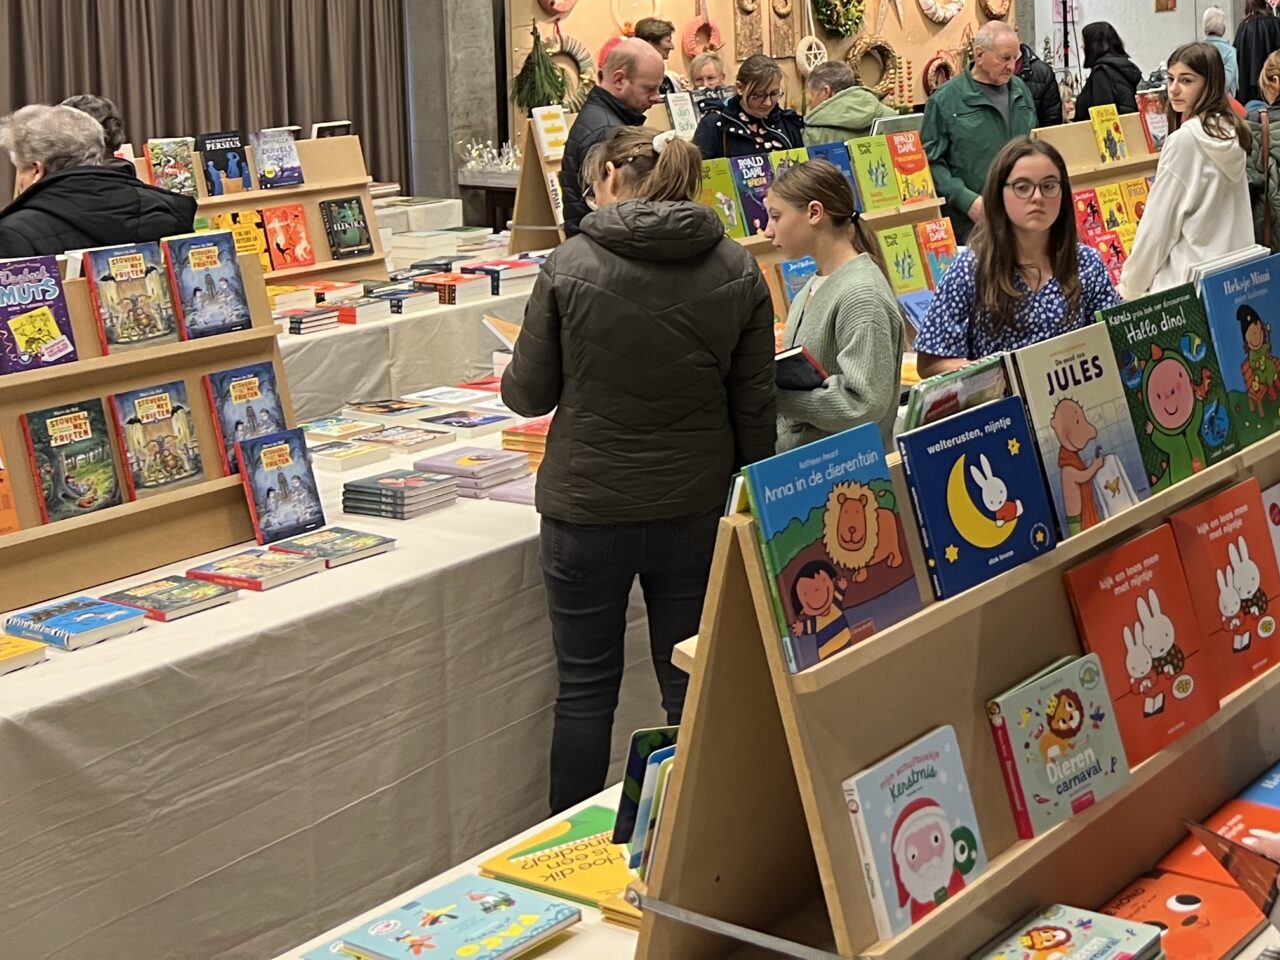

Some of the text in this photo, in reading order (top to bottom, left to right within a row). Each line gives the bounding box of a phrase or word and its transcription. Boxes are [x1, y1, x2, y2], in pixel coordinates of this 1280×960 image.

[205, 140, 241, 151] PERSEUS
[737, 156, 764, 169] ROALD
[742, 167, 765, 179] DAHL
[0, 277, 59, 307] MUTS
[1107, 310, 1132, 327] Karels
[1124, 306, 1187, 344] Hallo dino!
[1046, 355, 1104, 396] JULES
[50, 413, 88, 428] STOVERIJ
[72, 422, 88, 430] MET
[926, 416, 1012, 455] welterusten, nijntje
[54, 431, 90, 444] FRIETEN
[764, 450, 879, 505] Anna in de dierentuin
[1046, 747, 1096, 784] Dieren
[1056, 759, 1103, 796] carnaval
[889, 764, 939, 804] Kerstmis
[539, 853, 626, 883] Hoe dik
[545, 847, 609, 871] is een
